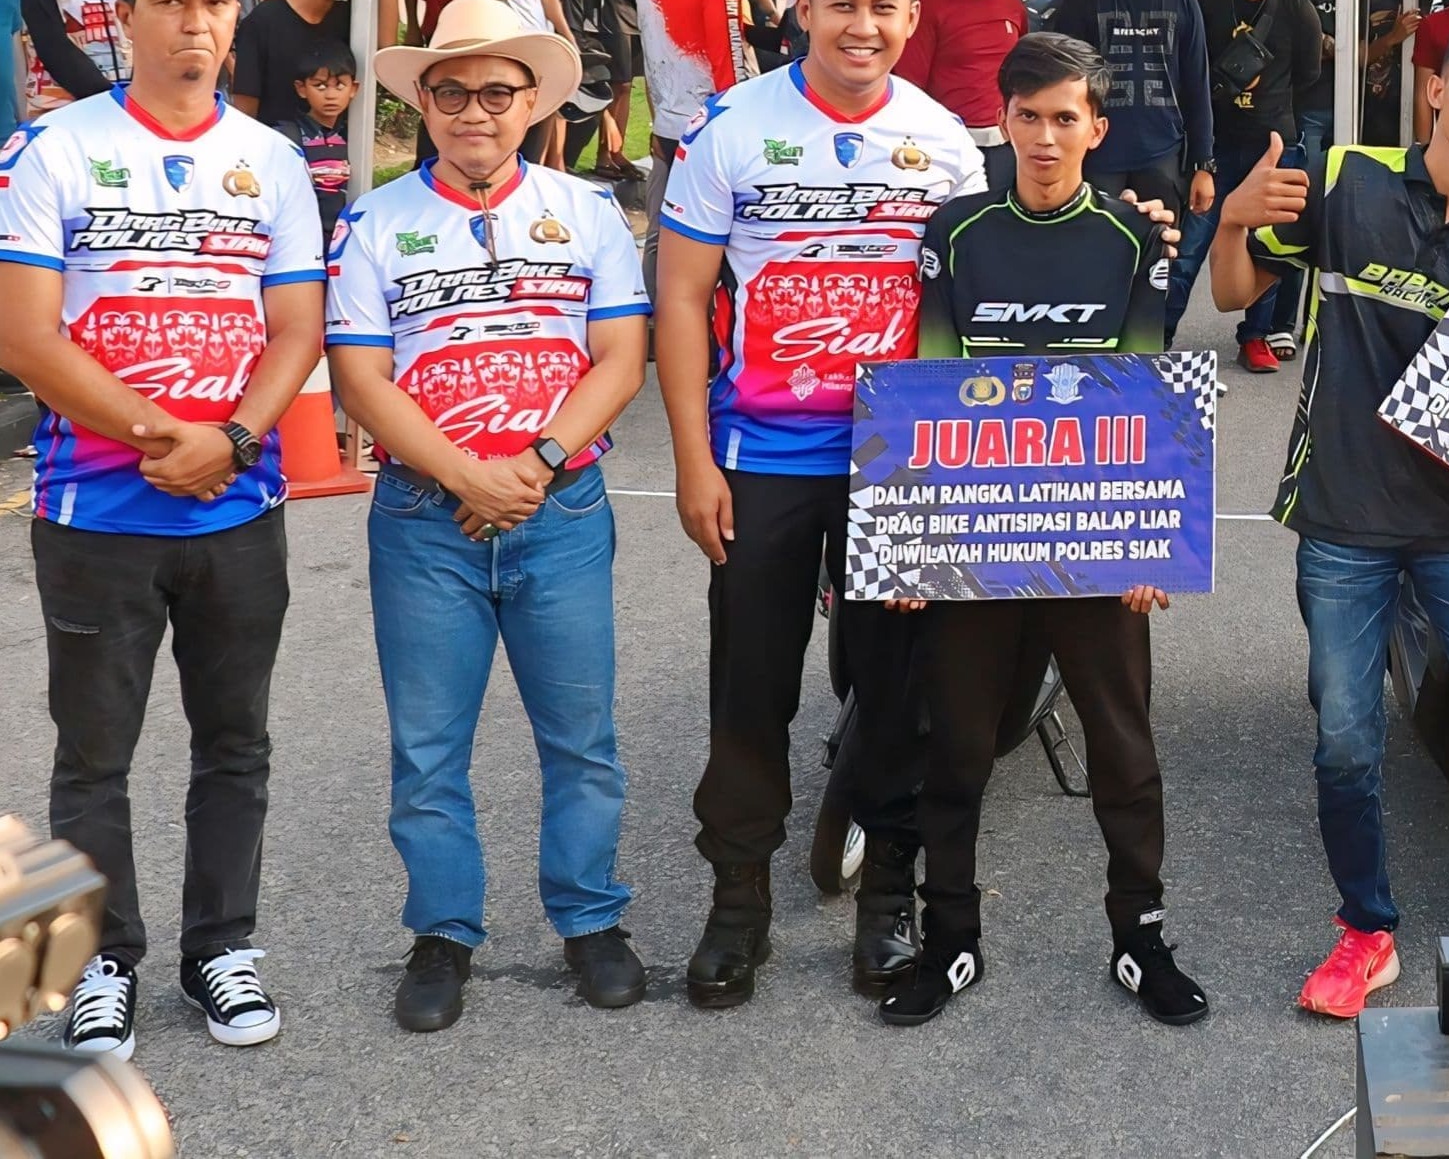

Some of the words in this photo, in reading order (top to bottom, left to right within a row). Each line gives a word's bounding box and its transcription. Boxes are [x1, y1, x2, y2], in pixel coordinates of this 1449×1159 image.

[971, 302, 1106, 324] SMKT
[770, 308, 907, 363] Siak
[908, 417, 1085, 469] JUARA
[1095, 415, 1147, 465] III
[873, 483, 935, 506] DALAM
[940, 482, 1014, 505] RANGKA
[1018, 480, 1096, 503] LATIHAN
[1101, 479, 1186, 501] BERSAMA
[875, 513, 925, 536] DRAG
[928, 513, 970, 534] BIKE
[973, 511, 1071, 533] ANTISIPASI
[1075, 510, 1135, 531] BALAP
[1139, 509, 1182, 530] LIAR
[986, 542, 1051, 563] HUKUM
[1054, 540, 1124, 561] POLRES
[1128, 538, 1171, 560] SIAK
